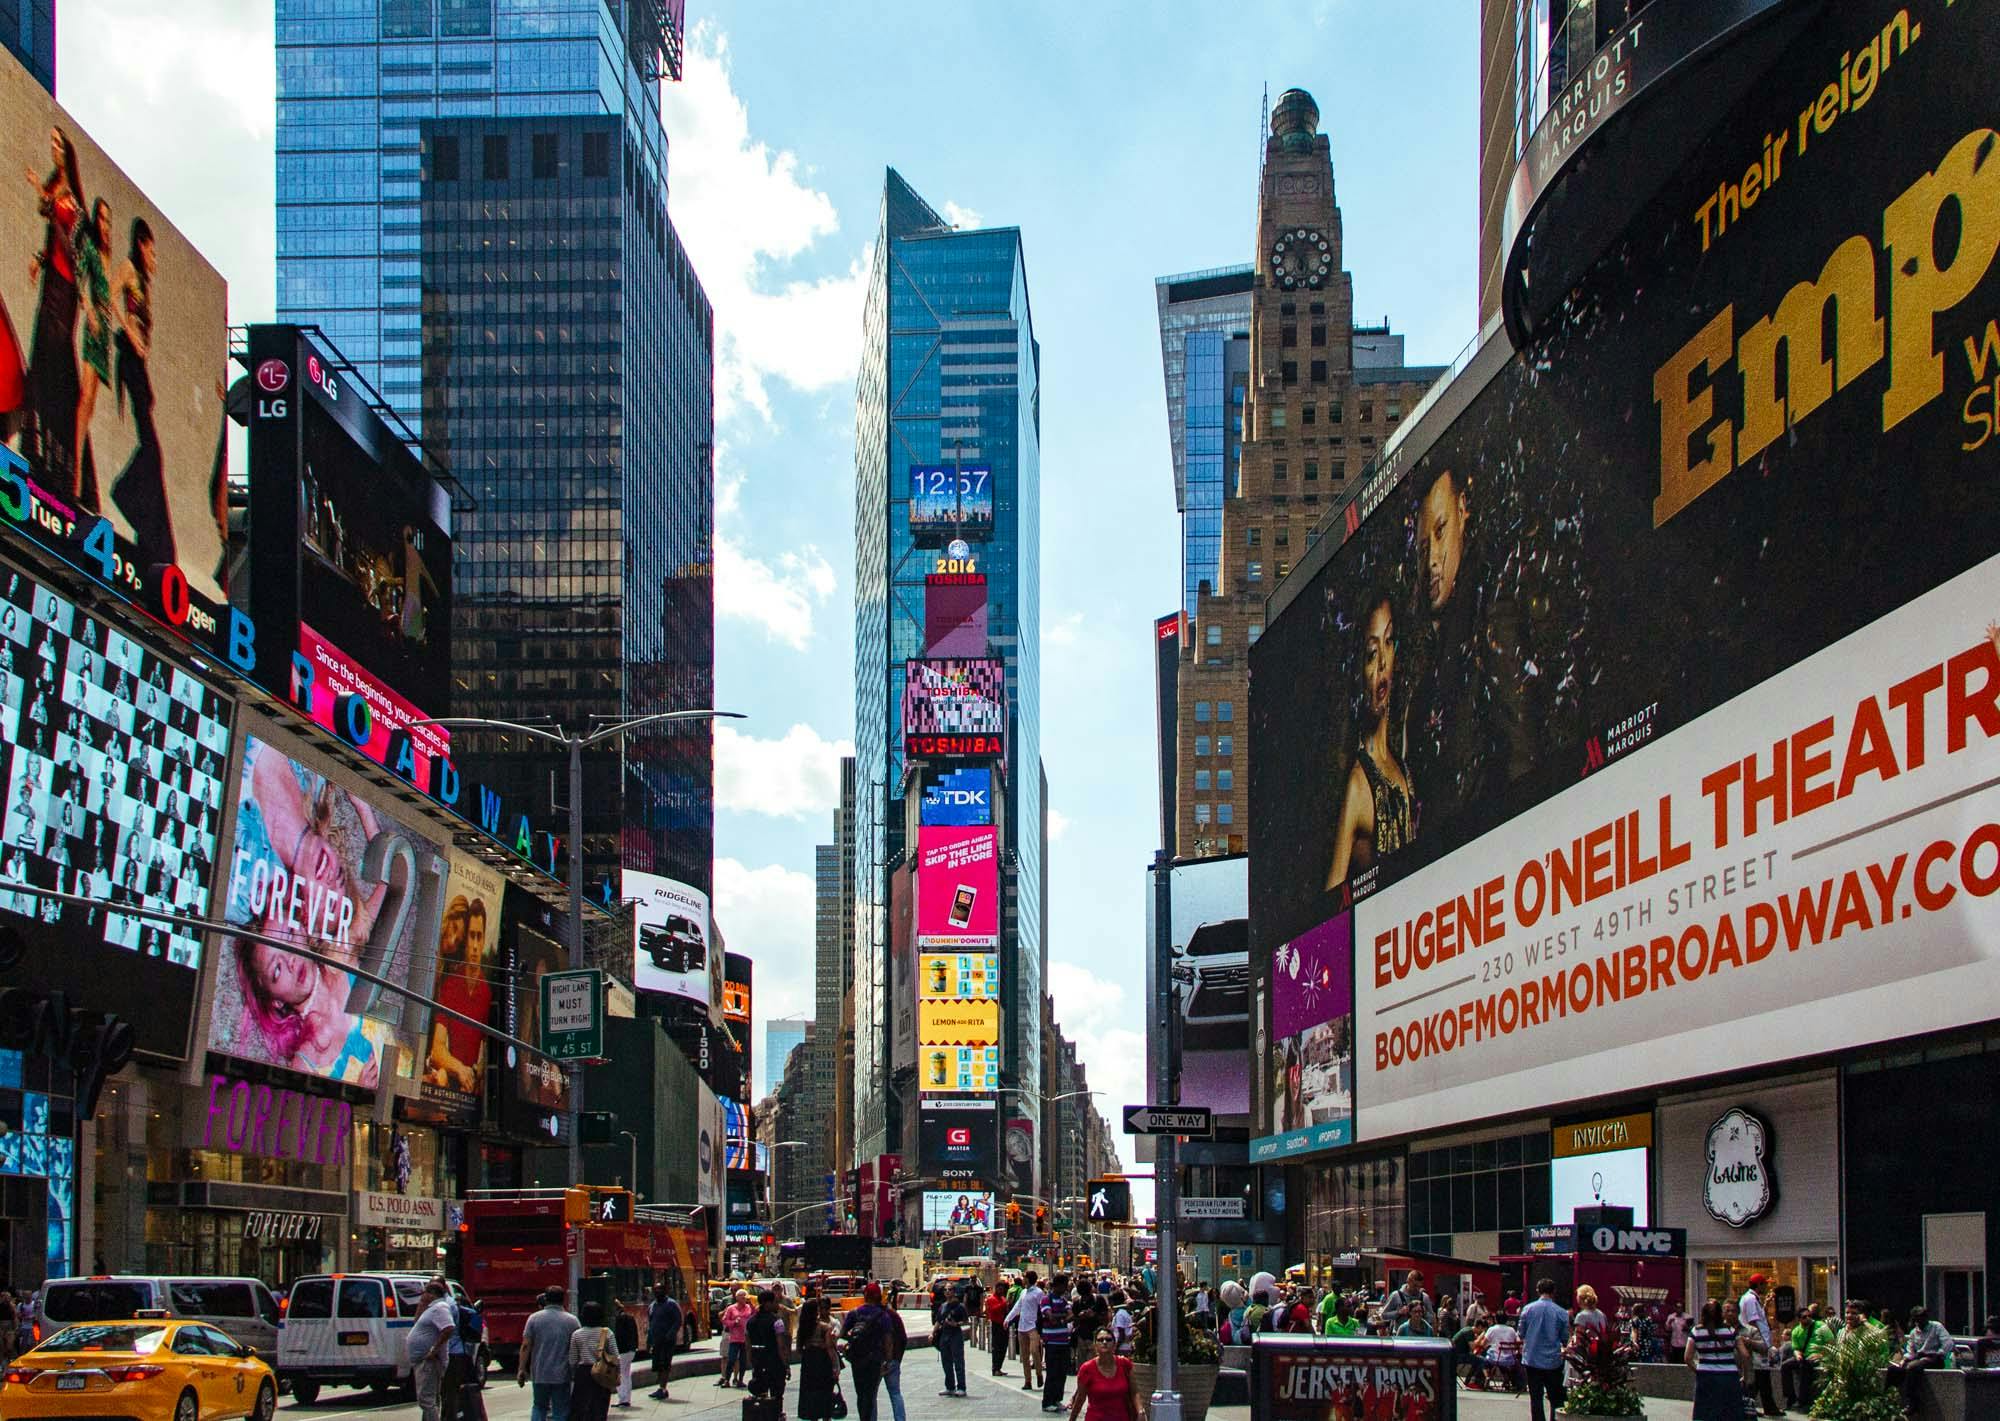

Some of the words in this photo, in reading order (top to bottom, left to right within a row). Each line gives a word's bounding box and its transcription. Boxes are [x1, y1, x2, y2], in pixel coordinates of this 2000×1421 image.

[1538, 22, 1645, 147] MARRIOTT
[1540, 70, 1628, 174] MARQUIS
[1695, 129, 1789, 253] Their
[1799, 9, 1921, 157] reign.
[1653, 128, 2000, 530] Emp
[322, 369, 337, 401] LG
[259, 399, 287, 418] LG
[914, 471, 988, 494] 12:57
[1362, 447, 1404, 502] MARRIOTT
[1362, 472, 1398, 520] MARQUIS
[937, 559, 975, 574] 2016
[927, 574, 985, 585] TOSHIBA
[316, 644, 339, 673] Since
[340, 663, 355, 683] the
[927, 687, 979, 697] TOSHIBA
[1607, 701, 1658, 741] MARRIOTT
[907, 736, 1001, 754] TOSHIBA
[1607, 723, 1652, 758] MARQUIS
[940, 790, 986, 805] TDK
[1375, 874, 1505, 989] EUGENE
[1515, 794, 1692, 927] O'NEILL
[1702, 640, 2000, 849] THEATR
[925, 853, 947, 866] SKIP
[949, 847, 969, 859] THE
[970, 840, 993, 854] LINE
[948, 859, 958, 869] IN
[960, 849, 993, 865] STORE
[1352, 865, 1379, 888] MARRIOTT
[232, 849, 354, 948] FOREVER
[655, 888, 702, 911] RIDGELINE
[1482, 947, 1515, 983] 230
[1524, 925, 1582, 968] WEST
[1592, 898, 1653, 941] 49TH
[1667, 849, 1779, 917] STREET
[1375, 823, 2000, 1072] BOOKOFMORMONBROADWAY.CO
[552, 984, 570, 995] RIGHT
[572, 981, 590, 993] LANE
[559, 998, 582, 1010] MUST
[551, 1015, 568, 1025] TURN
[571, 1014, 590, 1025] RIGHT
[566, 1032, 576, 1041] AT
[700, 1026, 709, 1069] 1500
[550, 1044, 558, 1056] W
[562, 1043, 575, 1055] 45
[580, 1042, 592, 1054] ST
[204, 1075, 352, 1166] FOREVER
[1150, 1114, 1173, 1126] ONE
[1177, 1114, 1201, 1127] WAY
[951, 1129, 966, 1143] G
[1573, 1121, 1629, 1150] INVICTA
[942, 1169, 974, 1177] SONY
[387, 1197, 410, 1215] POLO
[244, 1211, 304, 1239] FOREVER
[305, 1216, 321, 1240] 21
[1618, 1230, 1672, 1252] NYC
[1279, 1365, 1369, 1400] JERSEY
[1374, 1366, 1435, 1401] BOYS
